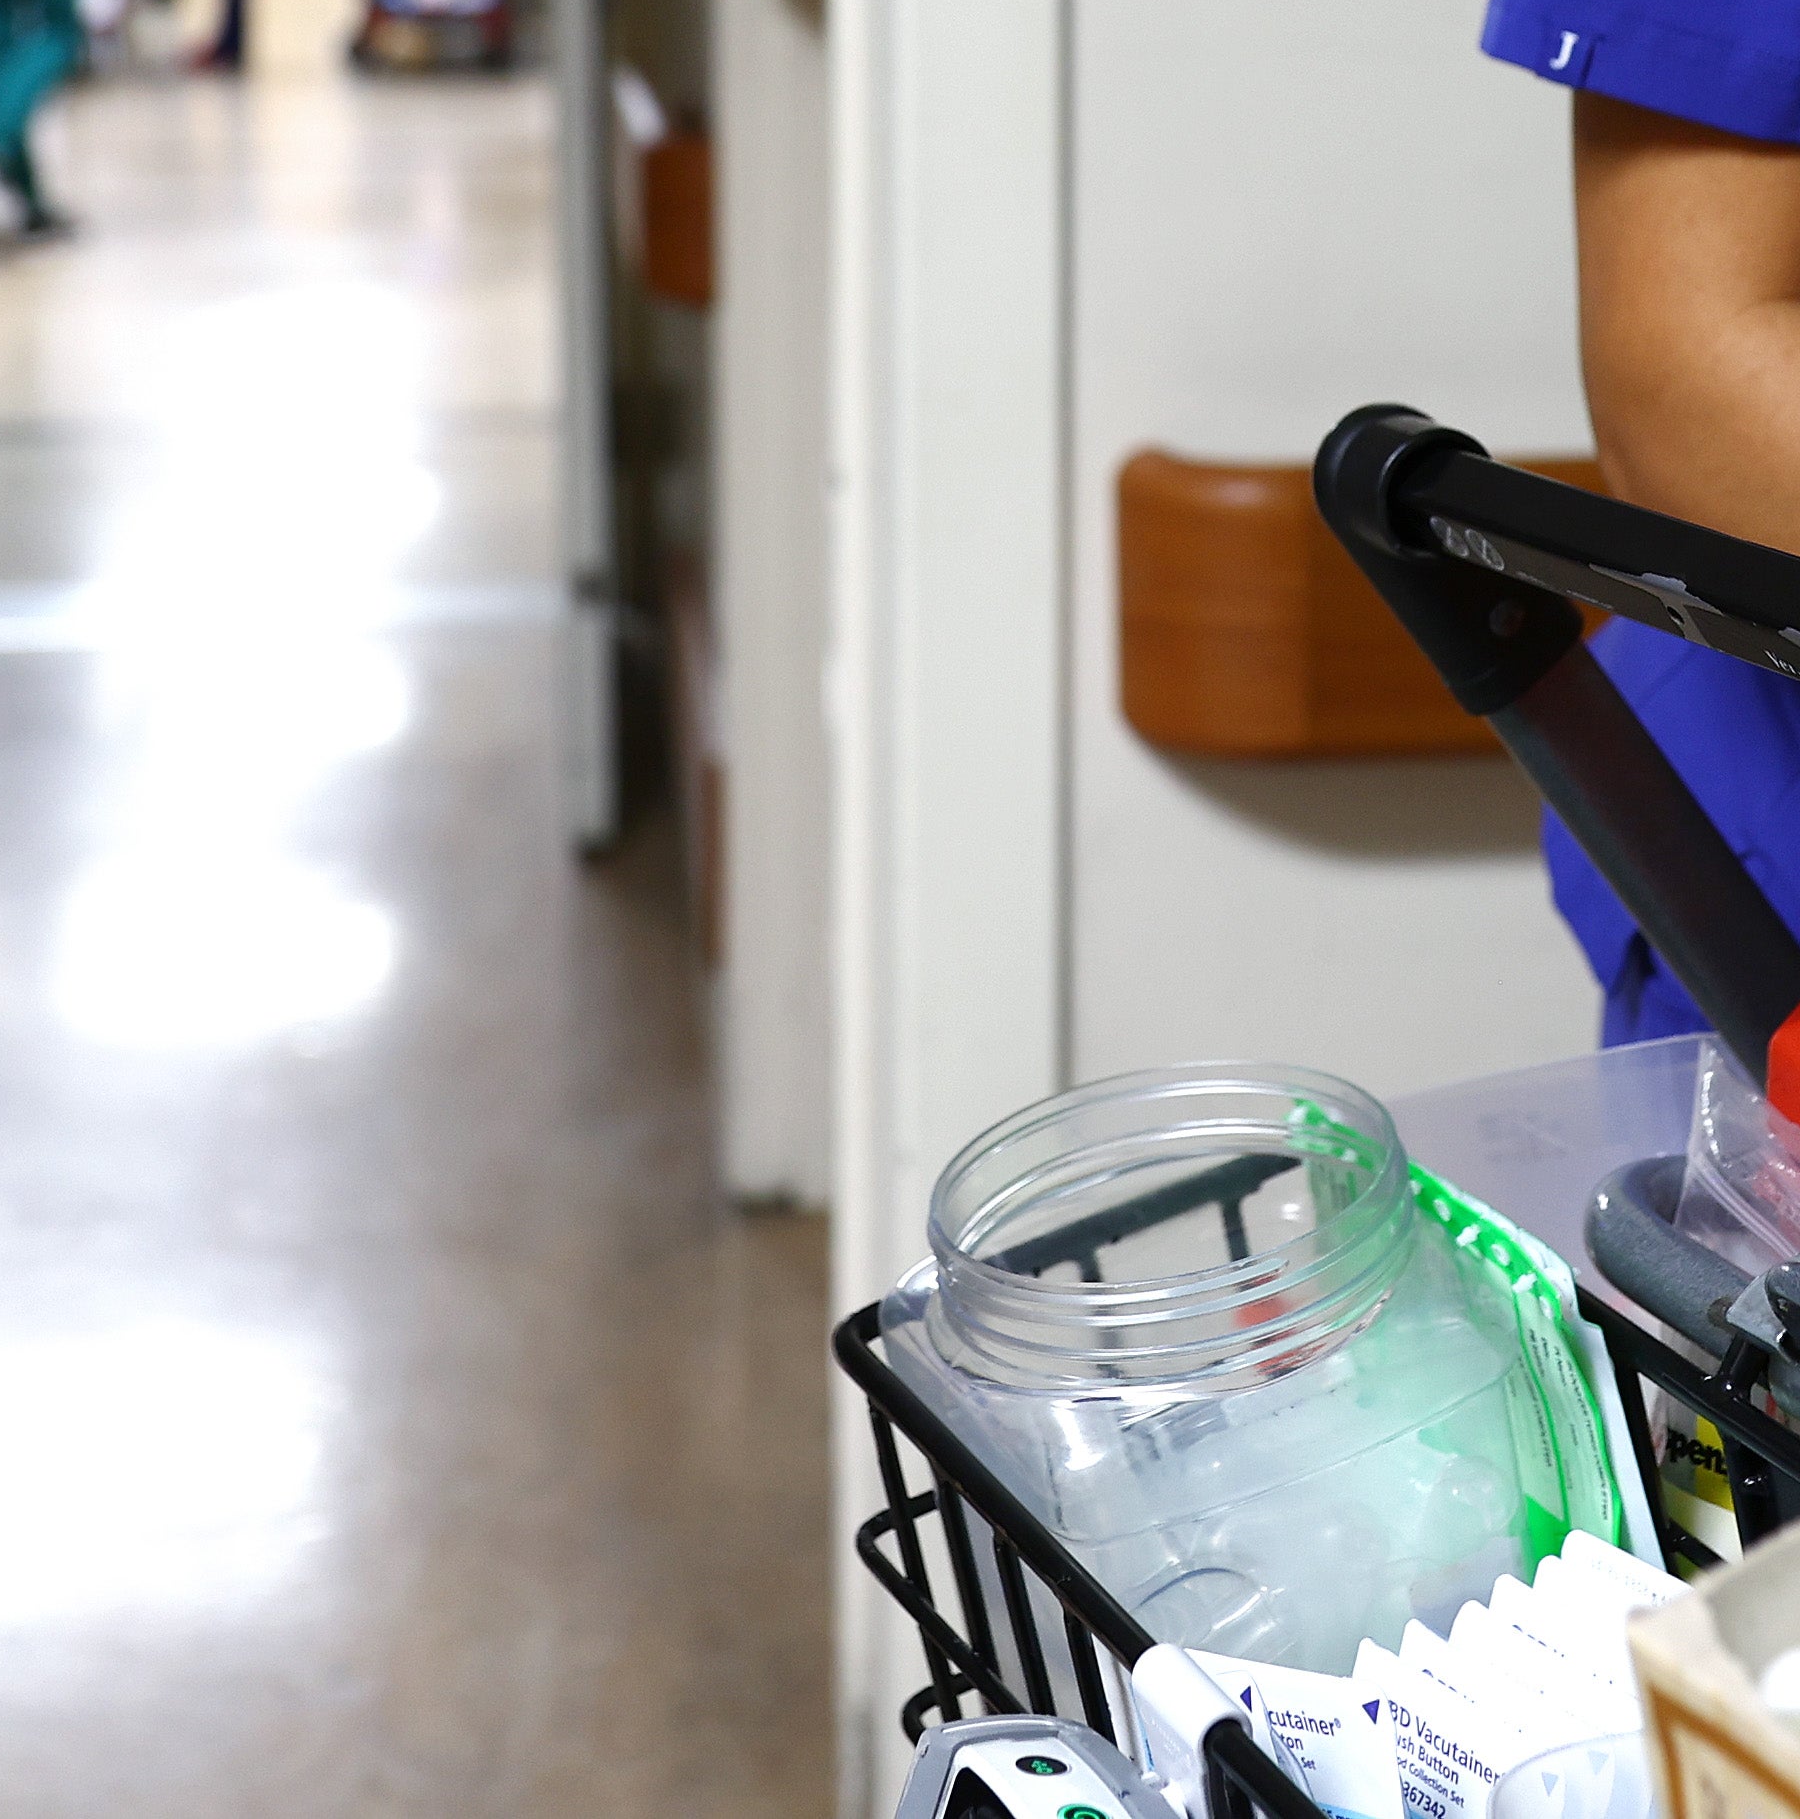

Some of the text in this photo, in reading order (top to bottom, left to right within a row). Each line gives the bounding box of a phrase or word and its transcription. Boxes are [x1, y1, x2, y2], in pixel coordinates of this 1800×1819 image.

[1549, 30, 1580, 70] J
[1408, 1761, 1449, 1798] Collection
[1450, 1786, 1465, 1809] Set
[1418, 1747, 1459, 1786] Button
